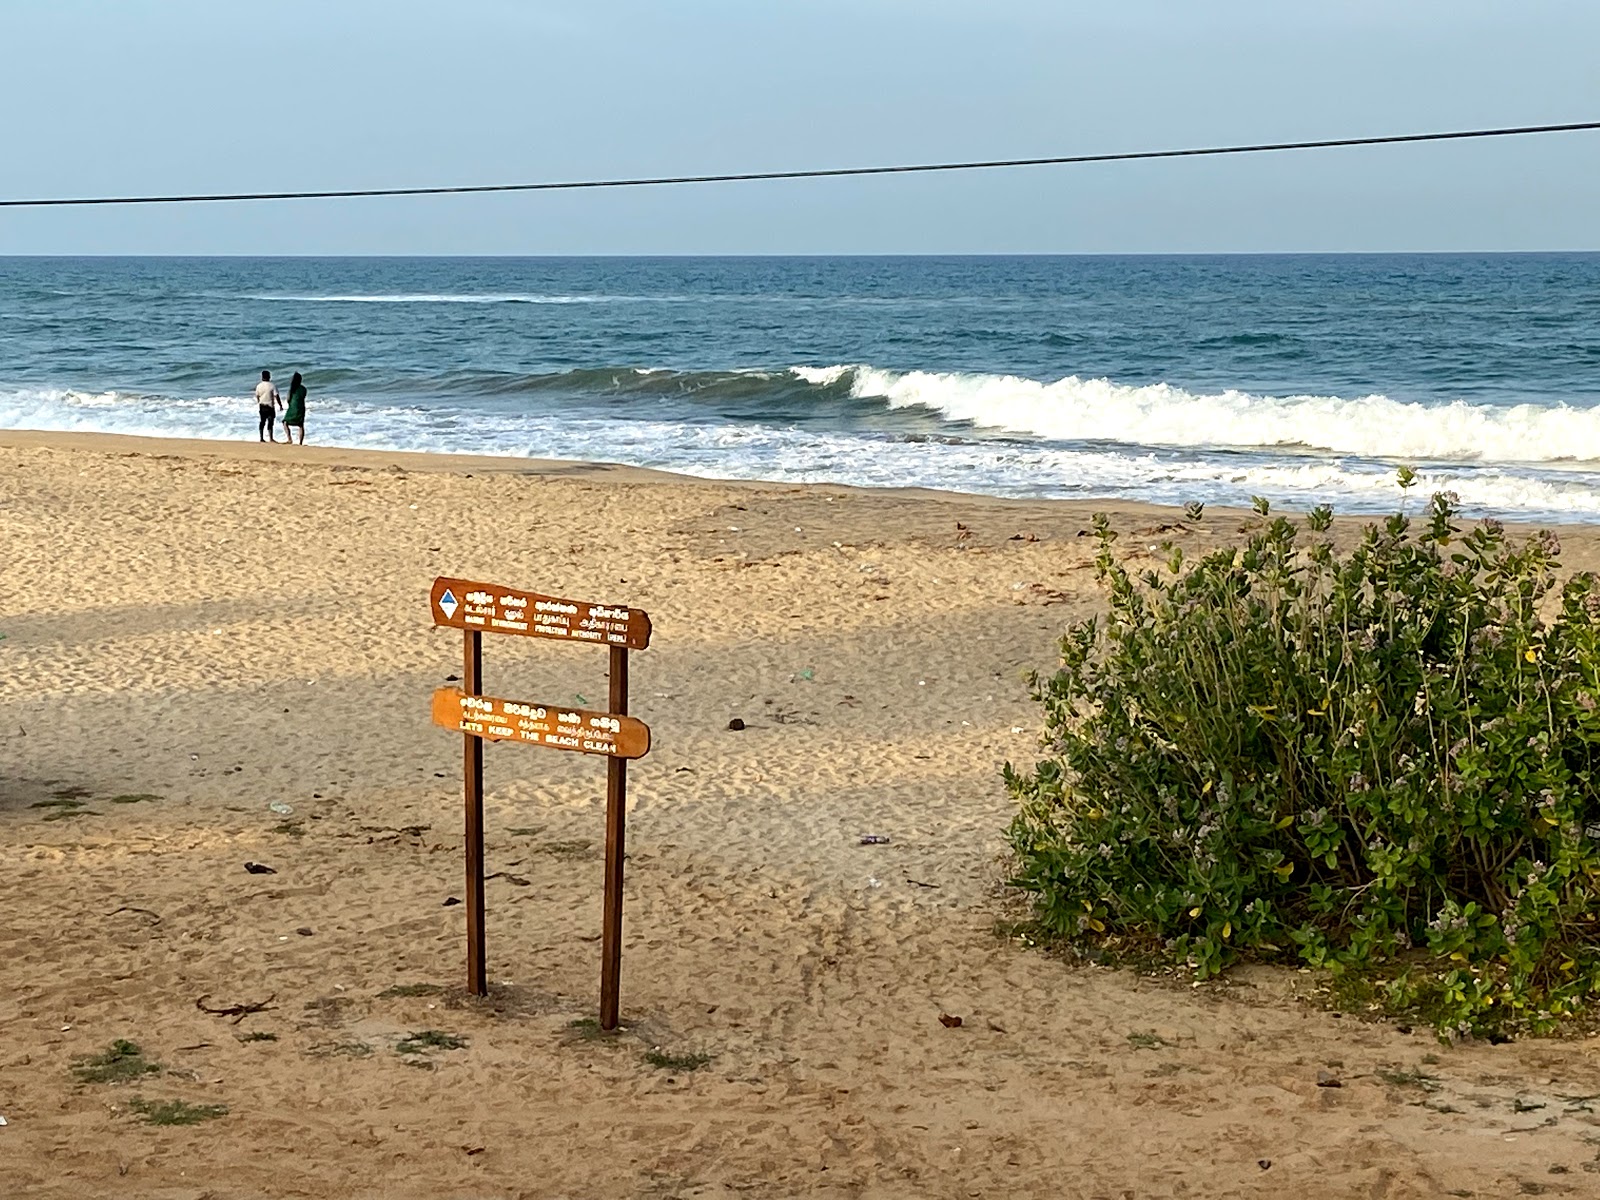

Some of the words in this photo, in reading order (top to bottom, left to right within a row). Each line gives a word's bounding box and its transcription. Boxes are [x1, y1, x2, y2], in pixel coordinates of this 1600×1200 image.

[459, 720, 483, 733] LETS
[488, 725, 514, 737] KEEP
[520, 730, 540, 741] THE
[545, 734, 579, 747] BEACH
[583, 740, 617, 753] CLEAN
